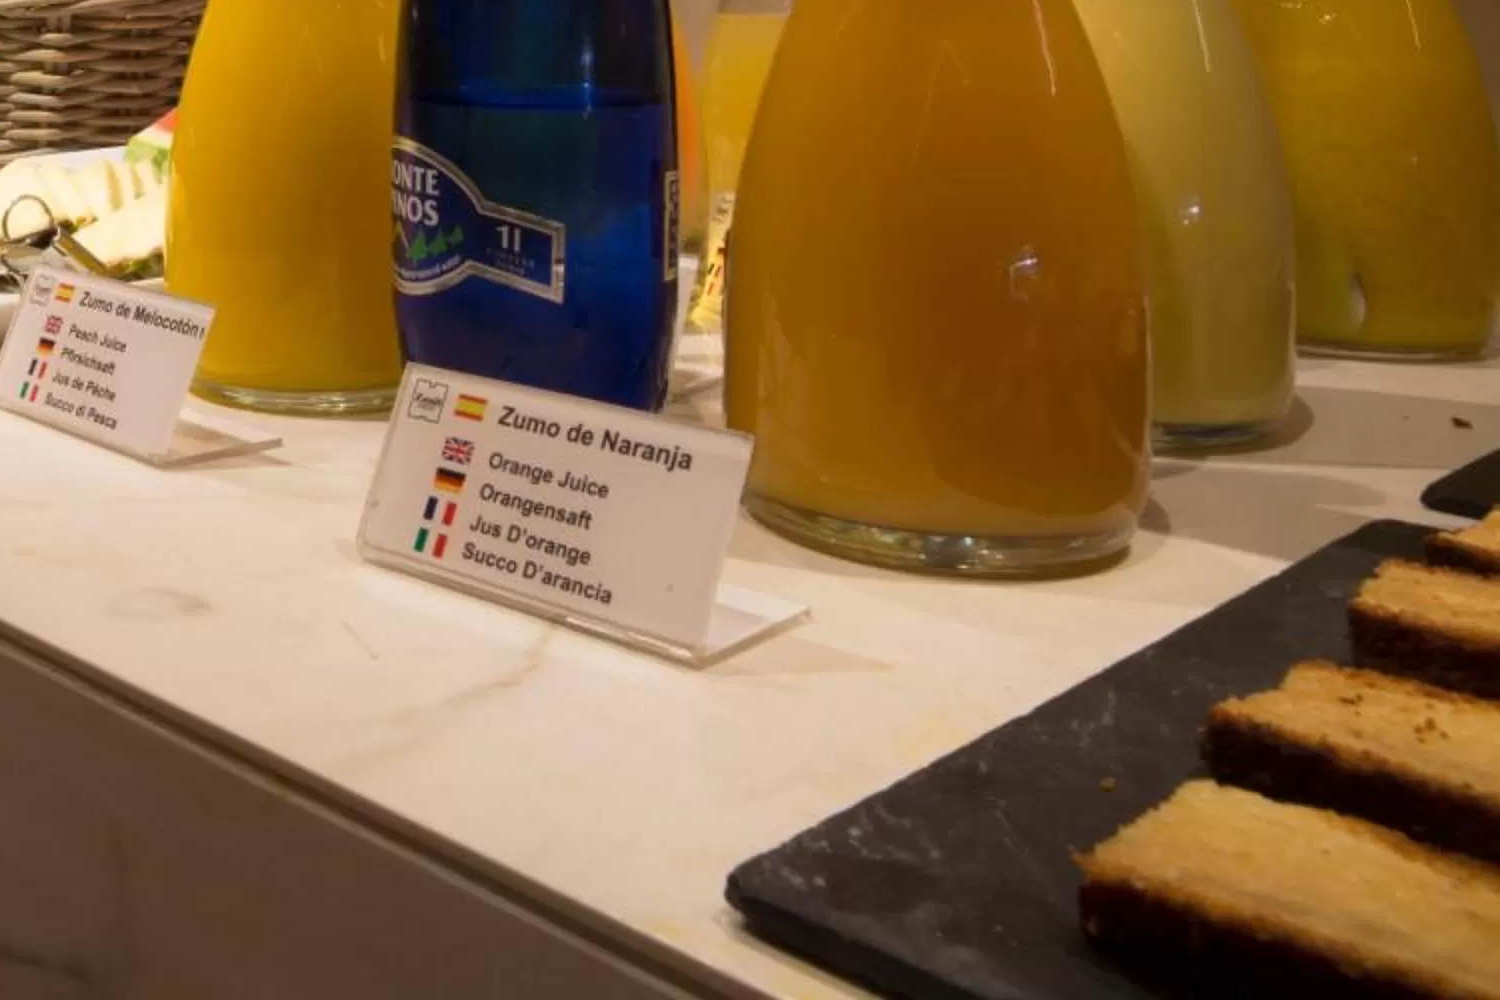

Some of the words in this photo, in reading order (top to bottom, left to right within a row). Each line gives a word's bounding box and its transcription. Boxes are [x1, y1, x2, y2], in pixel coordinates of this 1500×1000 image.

[392, 160, 440, 196] ONTE
[78, 291, 113, 313] Zumo
[115, 303, 132, 319] de
[132, 304, 199, 337] Melocotón
[68, 323, 99, 344] Peach
[99, 332, 127, 353] Juice
[51, 371, 70, 387] Jus
[70, 377, 84, 391] de
[43, 391, 75, 414] Succo
[75, 405, 87, 418] di
[87, 407, 118, 431] Pesca
[498, 405, 561, 438] Zumo
[566, 423, 595, 446] de
[601, 429, 694, 473] Naranja
[488, 452, 554, 485] Orange
[557, 471, 610, 499] Juice
[479, 483, 593, 531] Orangensaft
[469, 515, 502, 539] Jus
[506, 524, 592, 567] D'orange
[462, 541, 518, 574] Succo
[522, 560, 613, 604] D'arancia
